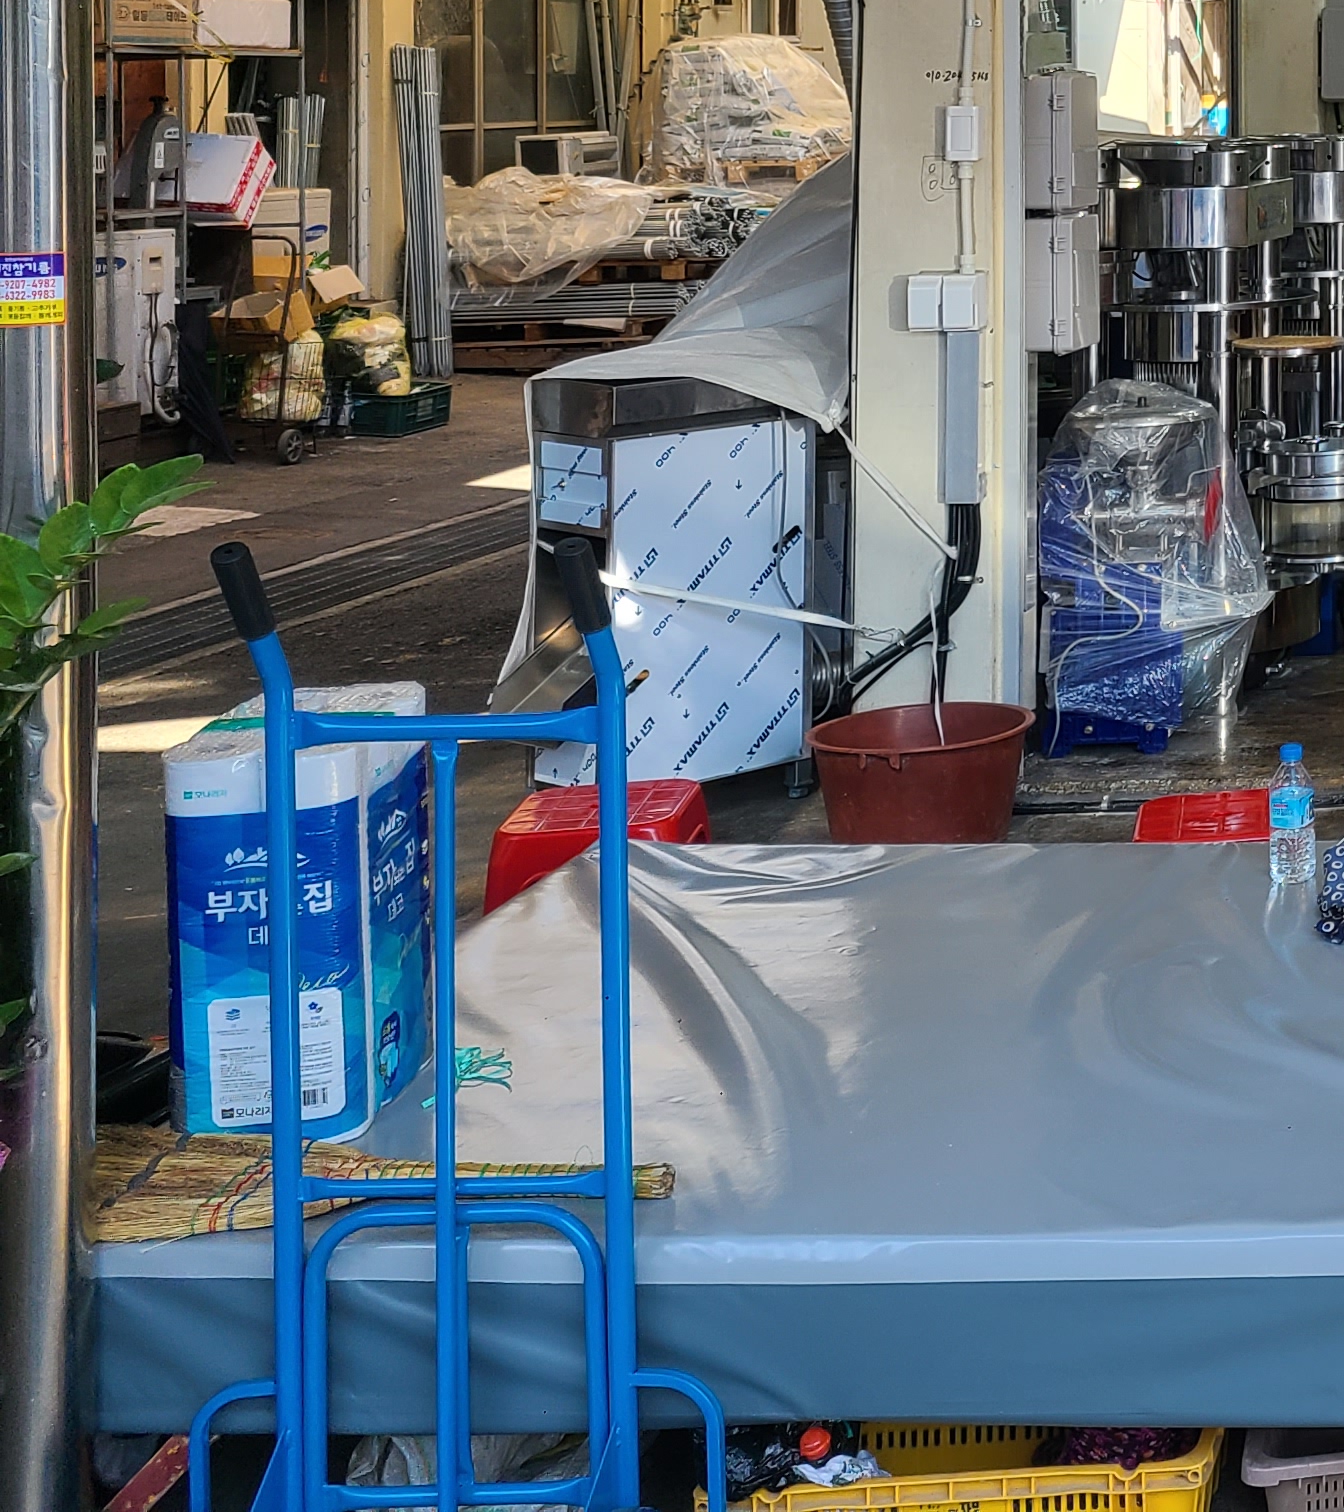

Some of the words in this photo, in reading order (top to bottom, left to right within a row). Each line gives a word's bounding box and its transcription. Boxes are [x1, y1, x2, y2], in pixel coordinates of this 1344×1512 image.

[0, 261, 51, 277] 진참기름
[205, 879, 334, 923] 부자집
[248, 925, 269, 946] 데
